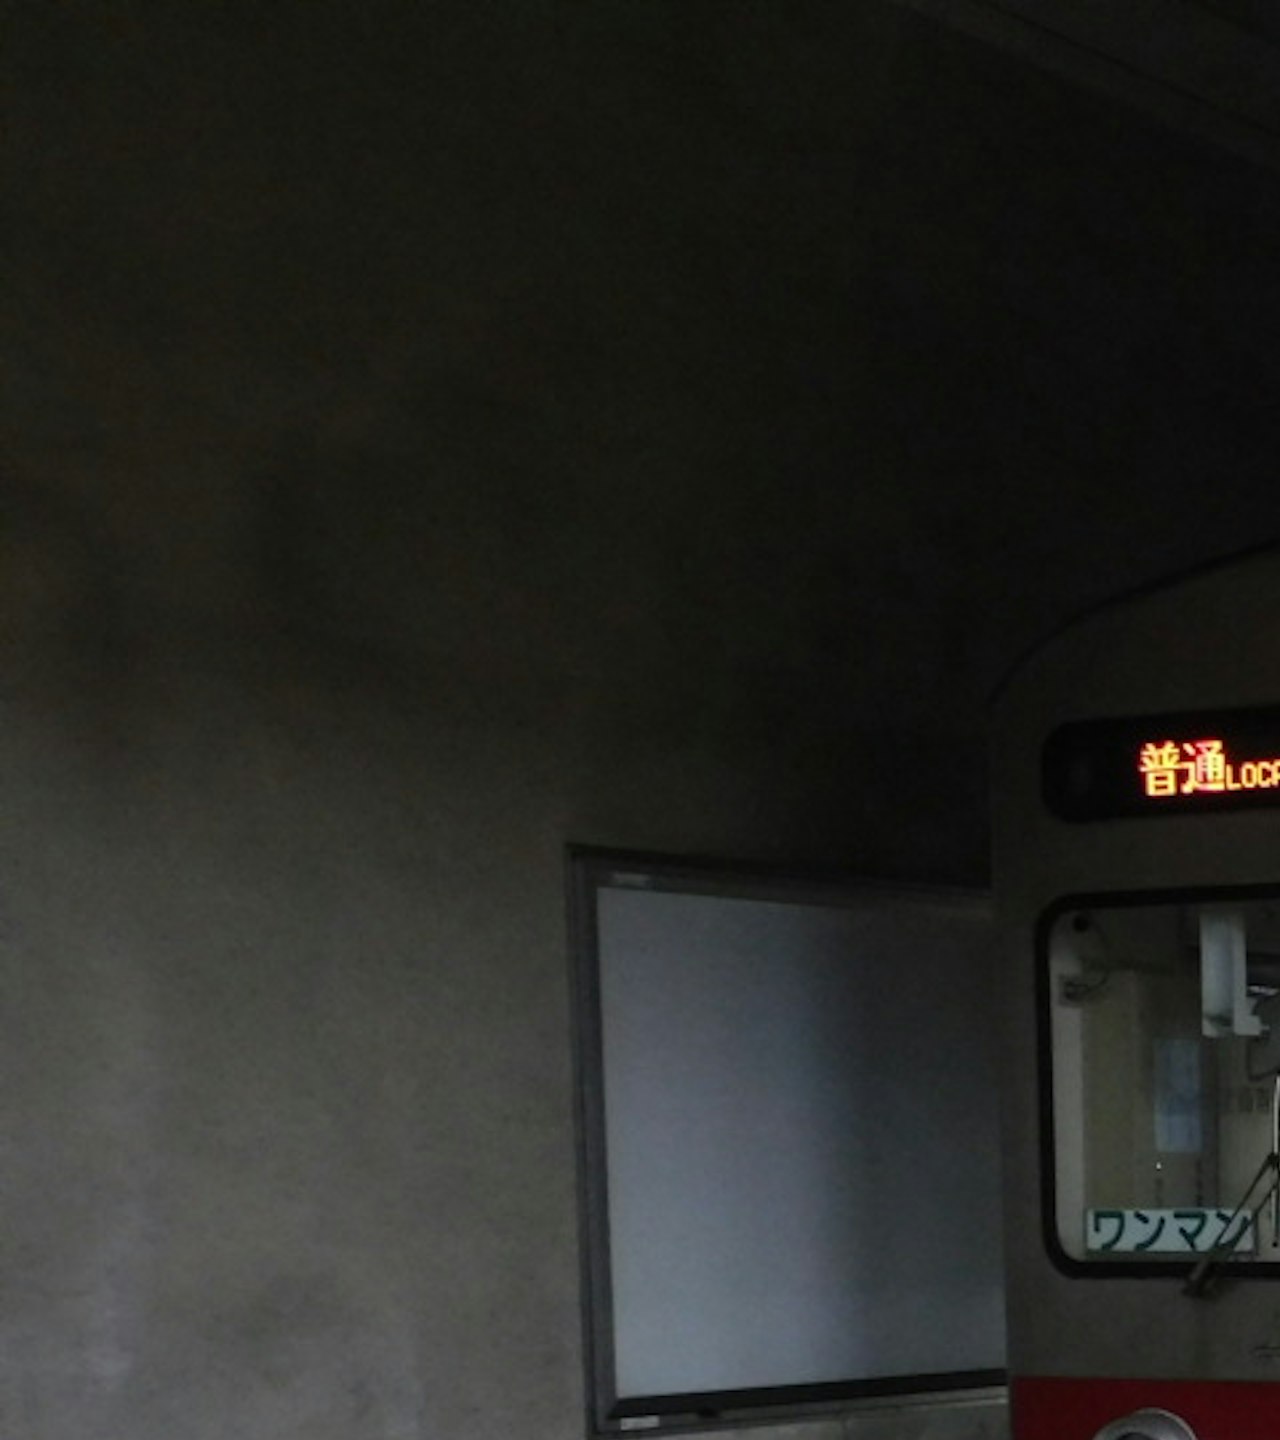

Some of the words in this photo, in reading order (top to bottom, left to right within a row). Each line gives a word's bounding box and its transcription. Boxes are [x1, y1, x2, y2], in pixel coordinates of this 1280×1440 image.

[1138, 739, 1226, 797] 普通
[1093, 1210, 1251, 1251] ワンマン
